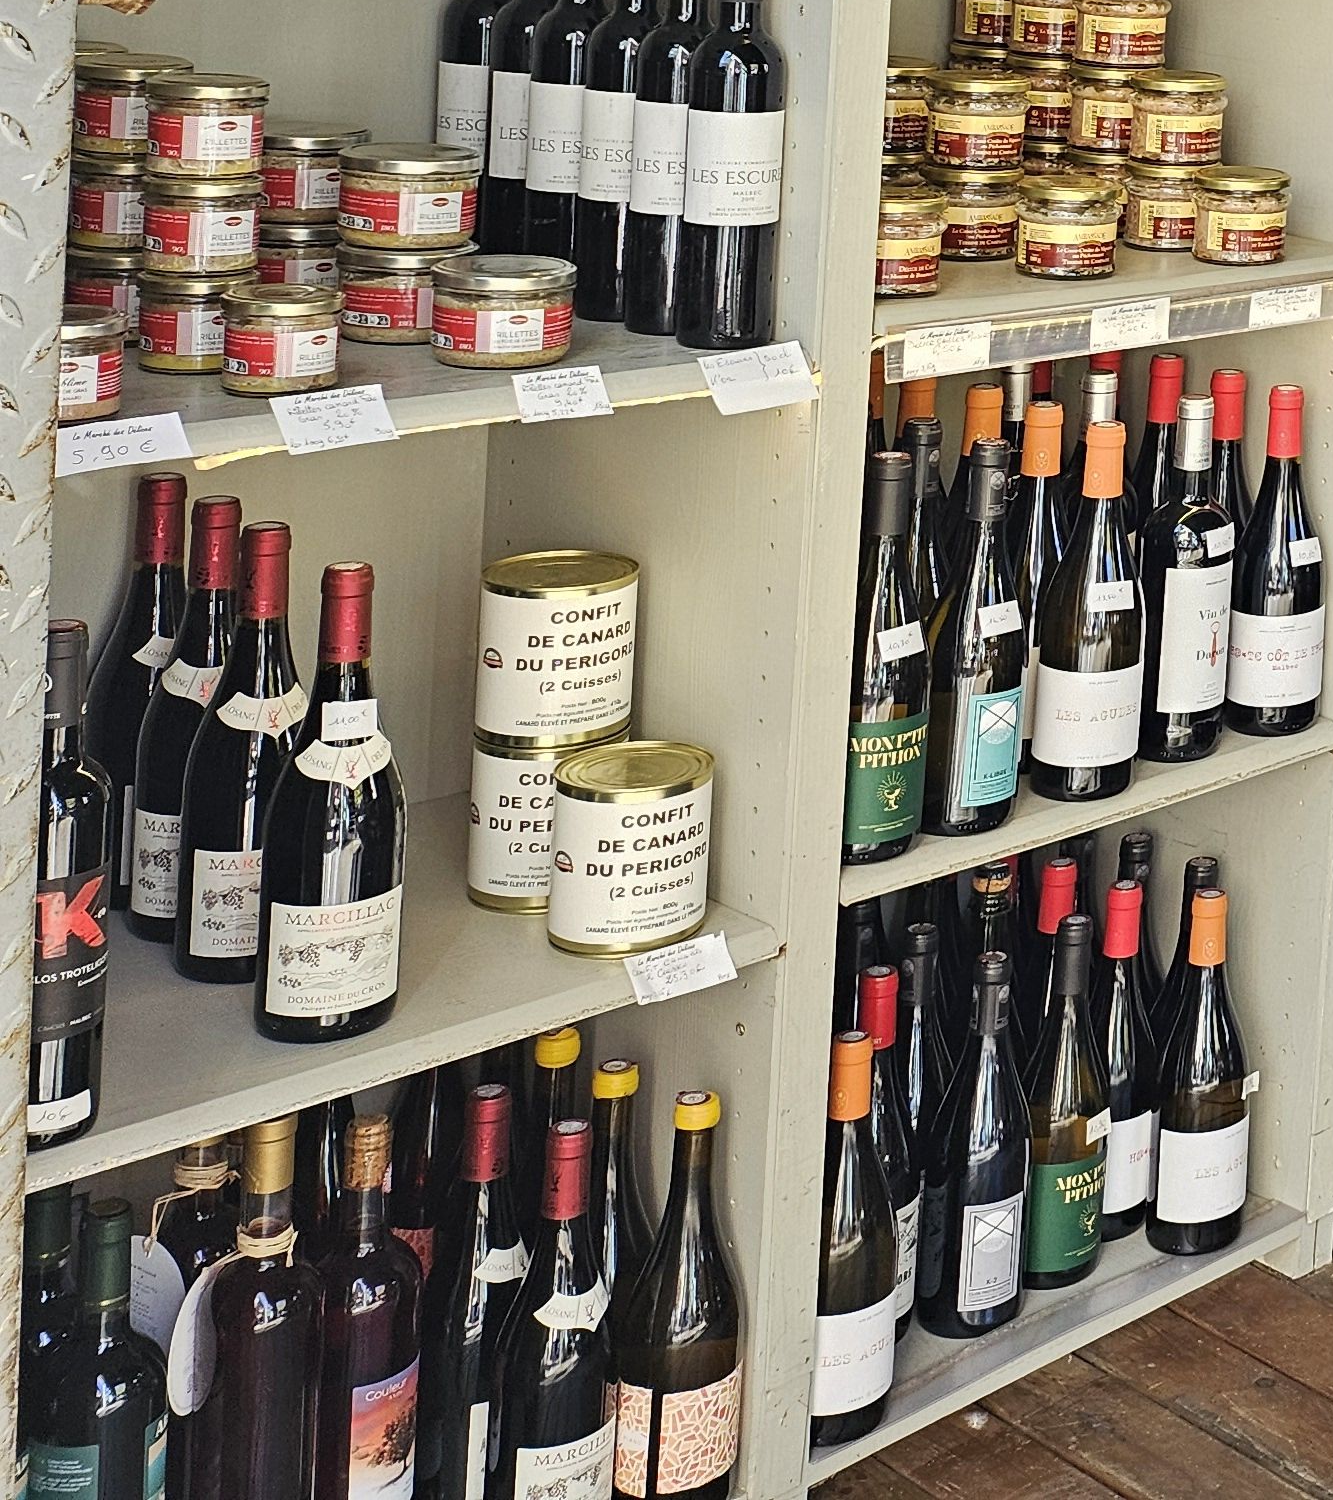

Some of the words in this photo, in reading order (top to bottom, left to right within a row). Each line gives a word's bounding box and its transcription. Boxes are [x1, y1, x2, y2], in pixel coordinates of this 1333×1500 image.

[499, 126, 528, 141] LES
[532, 137, 556, 153] LES
[636, 156, 661, 174] LES
[691, 168, 719, 185] LES
[496, 329, 540, 340] RILLETTES
[72, 444, 129, 466] 5,90
[550, 602, 623, 626] CONFIT
[1199, 608, 1218, 621] Vin
[527, 634, 556, 649] DE
[561, 621, 632, 647] CANARD
[515, 657, 543, 672] DU
[550, 642, 634, 672] PERIGORD
[539, 680, 556, 695] (2
[561, 669, 623, 692] Cuisses)
[1055, 706, 1081, 722] LES
[850, 737, 892, 754] MON
[857, 744, 921, 770] PITHON
[498, 795, 524, 810] DE
[488, 817, 515, 832] DU
[621, 802, 695, 830] CONFIT
[597, 838, 626, 853] DE
[632, 821, 705, 853] CANARD
[585, 862, 614, 878] DU
[621, 841, 708, 878] PERIGORD
[608, 883, 626, 902] (2
[630, 871, 695, 899] Cuisses)
[284, 896, 396, 928] MARCILLAC
[286, 991, 345, 1006] DOMAINE
[346, 990, 361, 1000] DU
[361, 981, 387, 999] CROS
[1193, 1164, 1221, 1181] LES
[821, 1352, 850, 1369] LES
